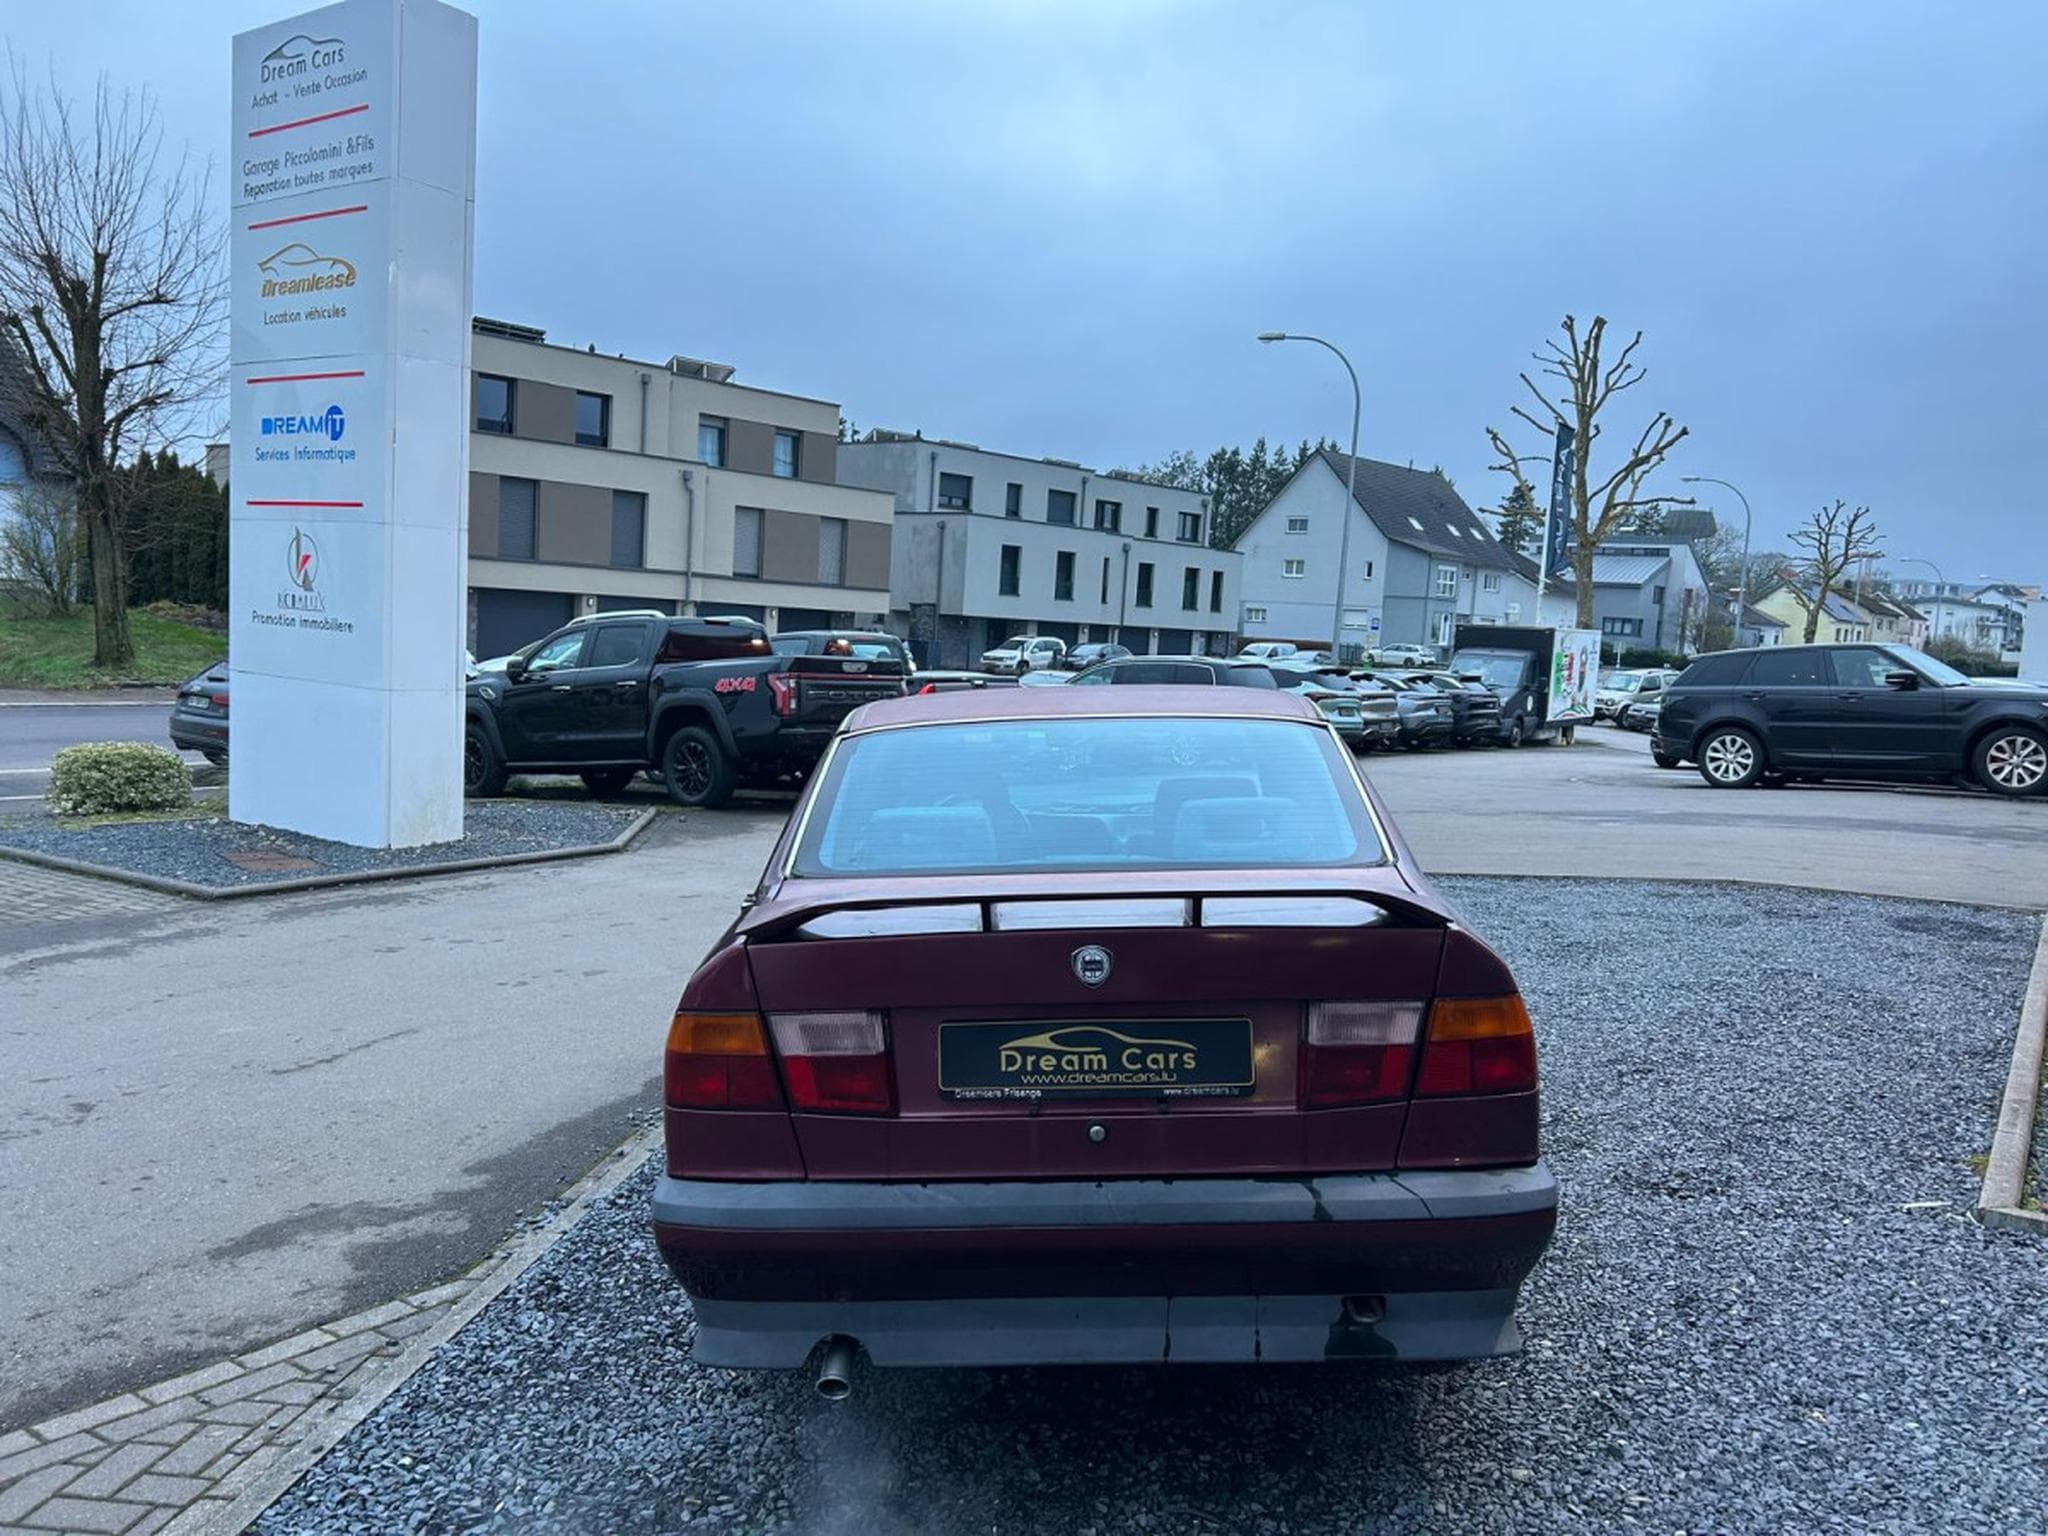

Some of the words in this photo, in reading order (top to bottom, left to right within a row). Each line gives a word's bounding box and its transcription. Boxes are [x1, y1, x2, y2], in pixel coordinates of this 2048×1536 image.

[260, 58, 307, 83] Dream
[311, 47, 345, 70] Cars
[251, 90, 278, 109] Achat
[293, 80, 321, 98] Vente
[324, 68, 368, 90] Occasion
[243, 158, 280, 177] Garage
[284, 140, 343, 168] Piccolomini
[294, 171, 325, 188] toutes
[328, 161, 374, 181] marques
[260, 272, 356, 297] Dreamlease
[263, 308, 302, 325] Location
[255, 447, 290, 461] Services
[294, 446, 356, 464] Informatique
[252, 609, 297, 629] Promotion
[1000, 1049, 1107, 1073] Dream
[1121, 1048, 1197, 1071] Cars
[1020, 1071, 1178, 1085] www.dreamcars.lu
